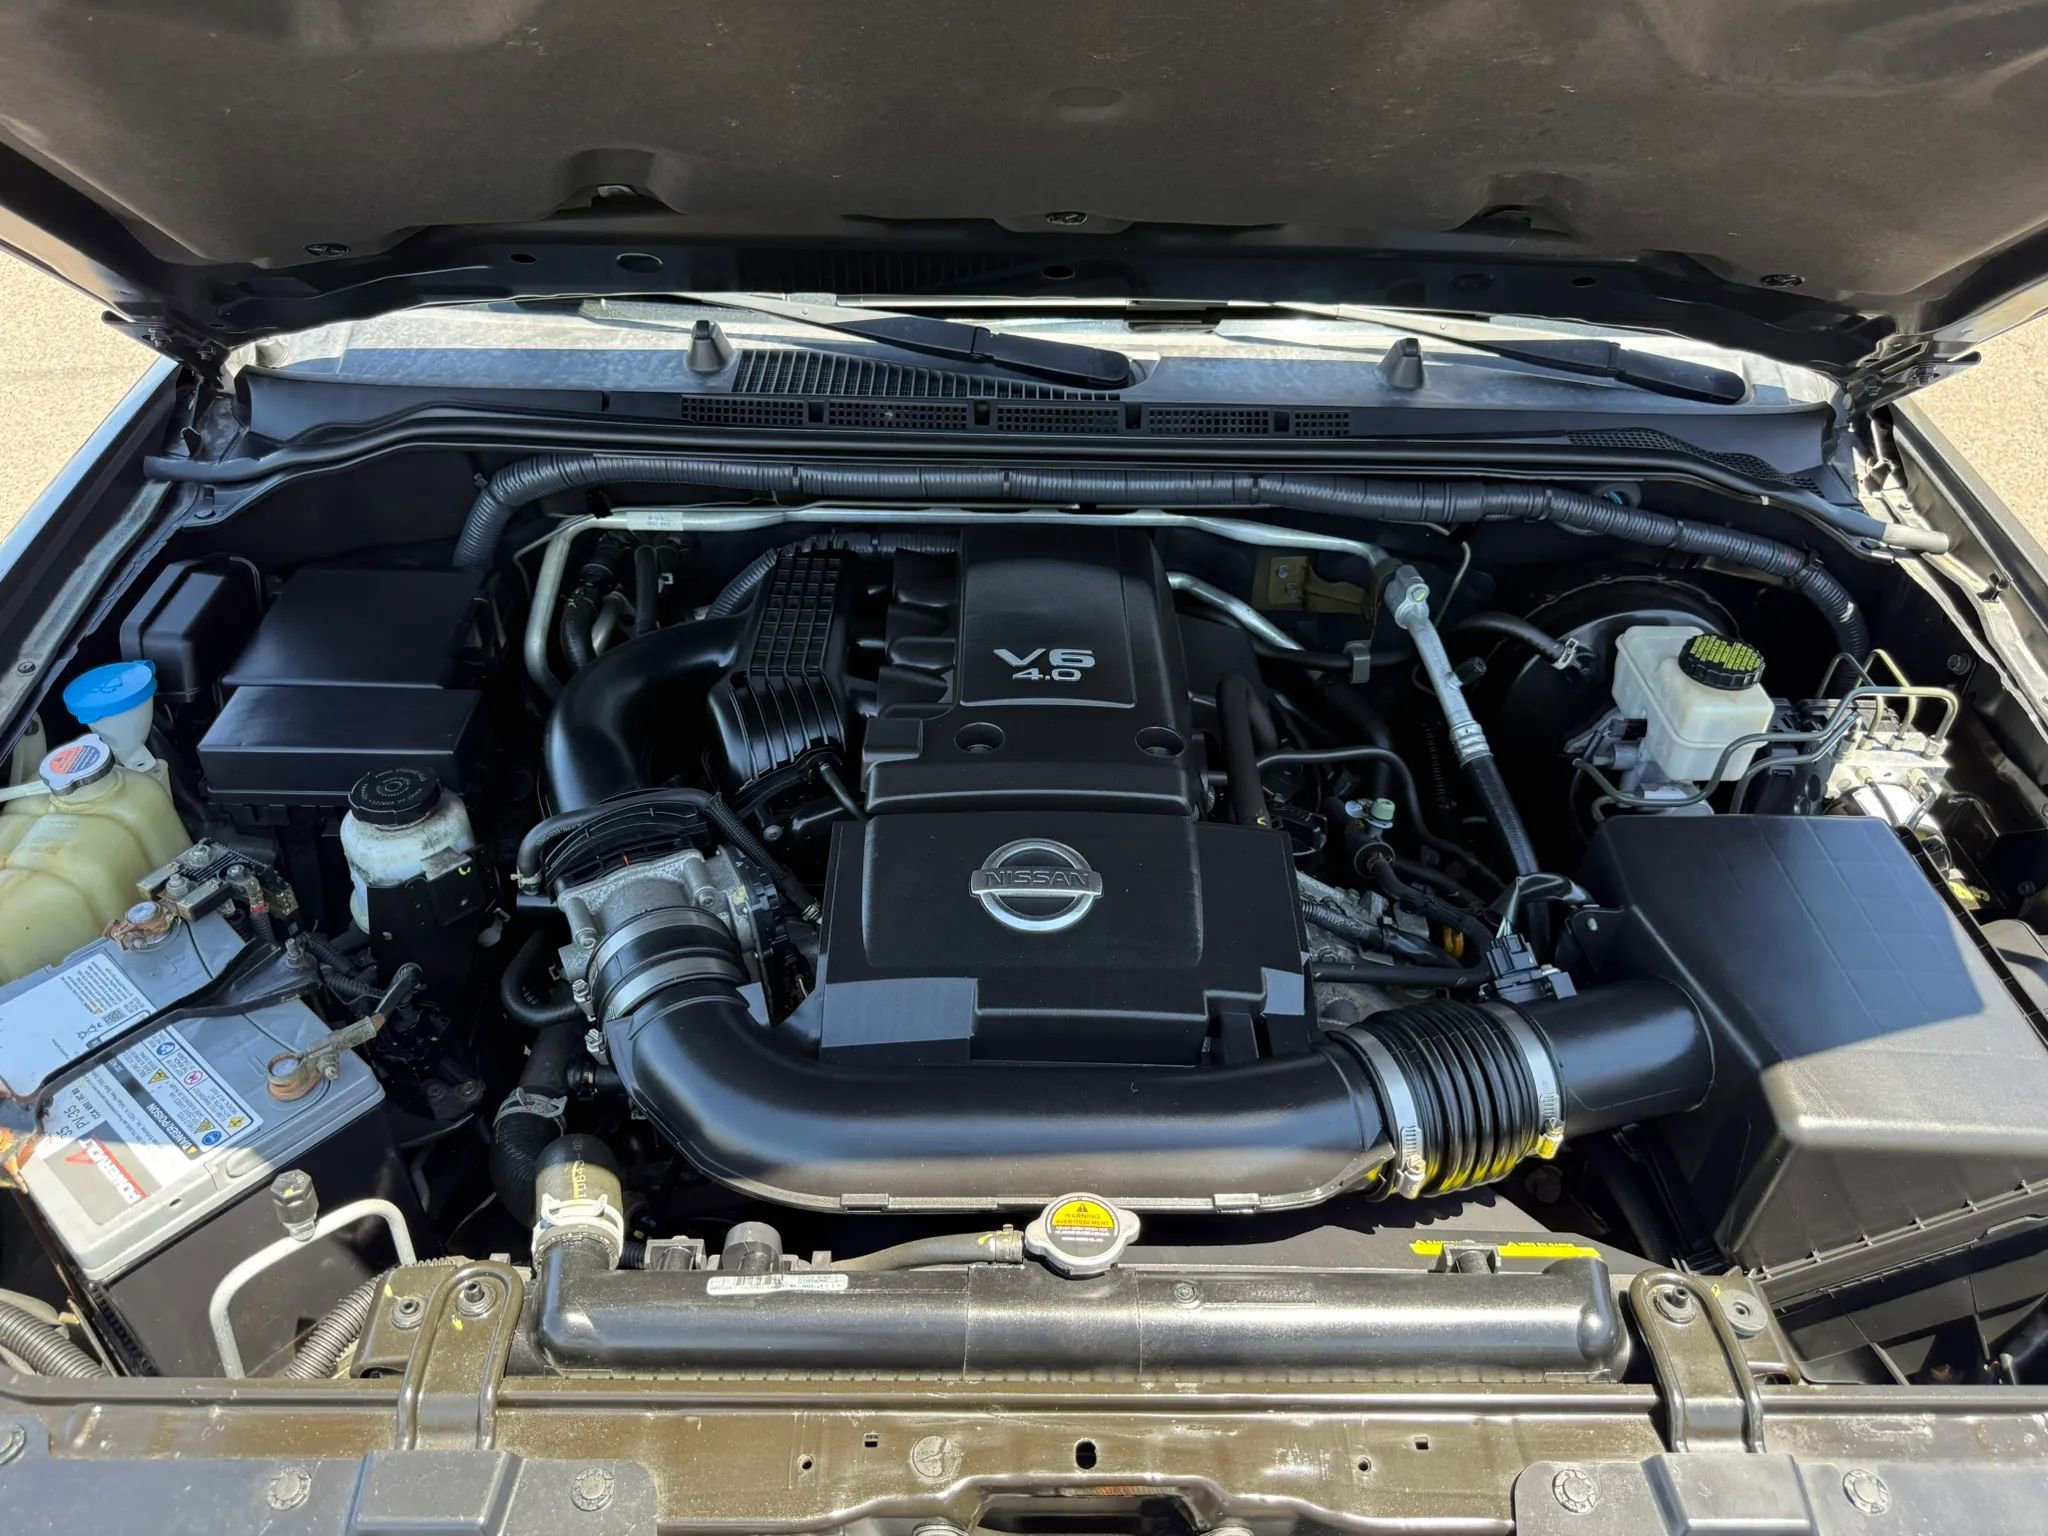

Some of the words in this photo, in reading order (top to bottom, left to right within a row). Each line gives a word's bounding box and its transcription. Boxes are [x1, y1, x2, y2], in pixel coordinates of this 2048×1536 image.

[993, 648, 1096, 668] V6
[1012, 668, 1082, 681] 4.0
[985, 870, 1089, 887] NISSAN
[62, 1103, 91, 1130] PV-35
[145, 1101, 192, 1149] DANGER/POISON
[55, 1124, 74, 1140] 35
[76, 1132, 143, 1206] POWERVOLT
